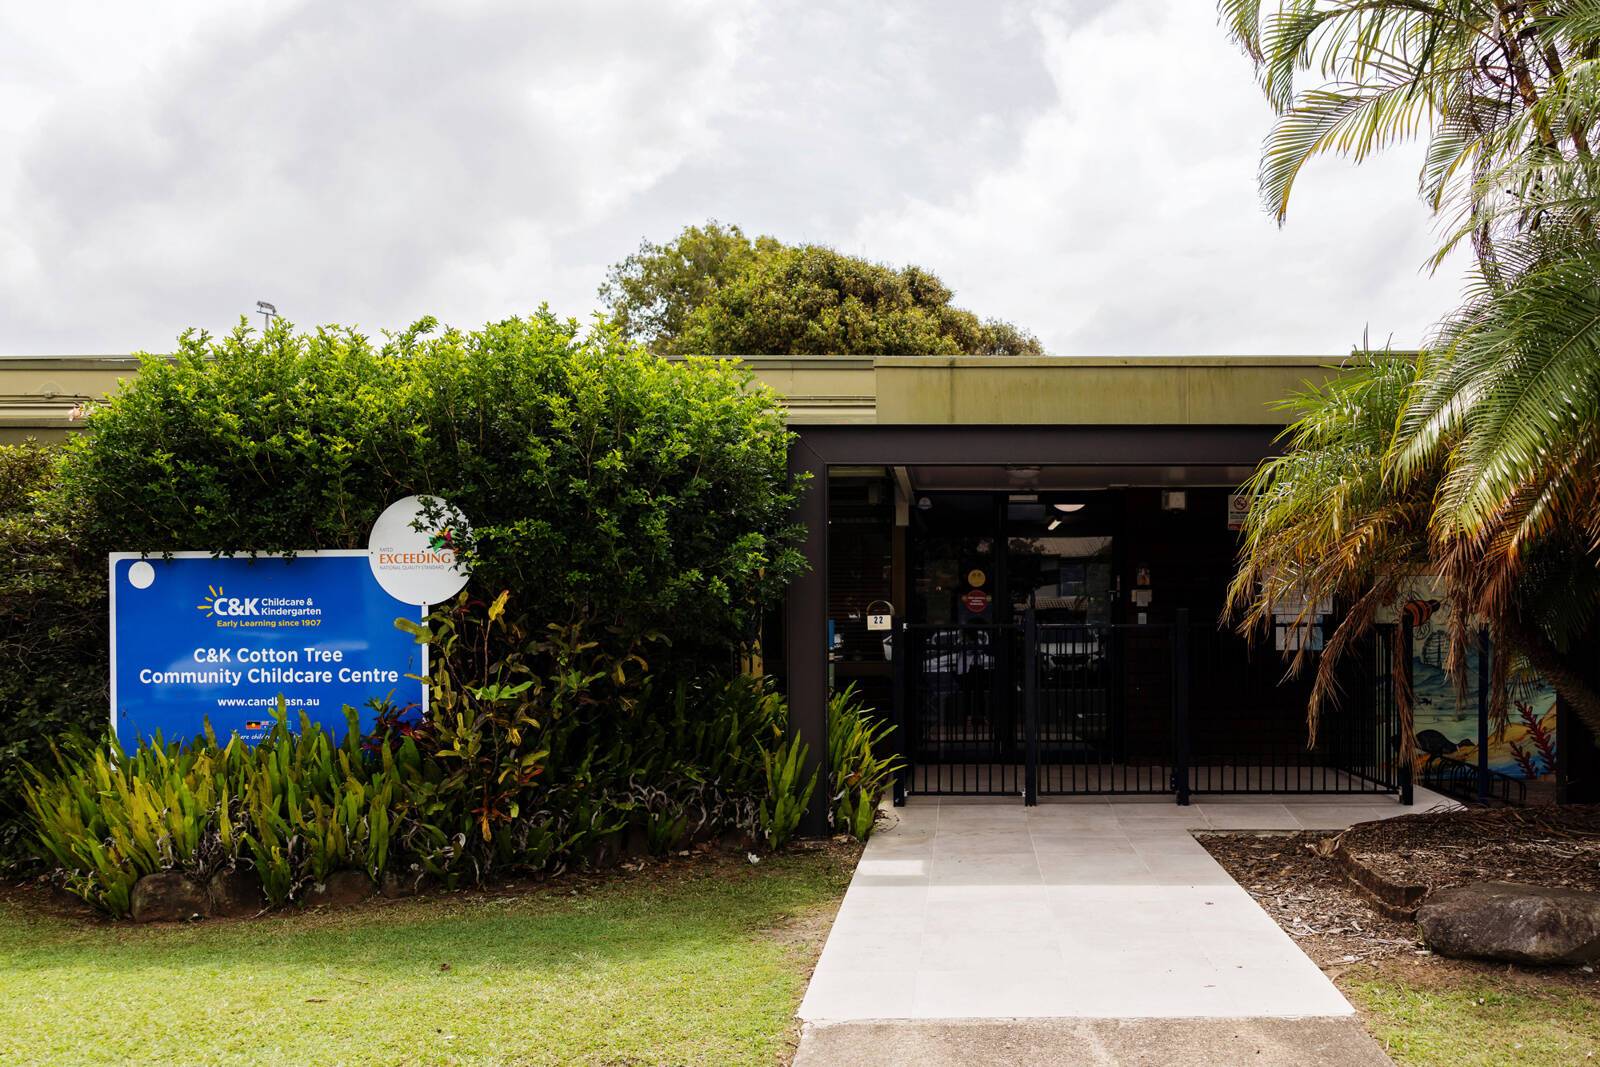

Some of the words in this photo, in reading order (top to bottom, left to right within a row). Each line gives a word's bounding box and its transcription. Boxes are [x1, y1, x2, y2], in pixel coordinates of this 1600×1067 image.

[379, 553, 451, 564] EXCEEDING
[213, 597, 260, 616] C&K
[261, 598, 304, 606] Childcare
[306, 597, 313, 606] &
[261, 607, 321, 617] Kindergarten
[217, 620, 238, 628] Early
[240, 620, 276, 628] Learning
[301, 619, 321, 627] 1907
[873, 616, 884, 625] 22
[193, 648, 231, 663] C&K
[236, 648, 298, 663] Cotton
[304, 648, 343, 663] Tree
[139, 668, 242, 686] Community
[247, 667, 333, 683] Childcare
[338, 667, 399, 683] Centre
